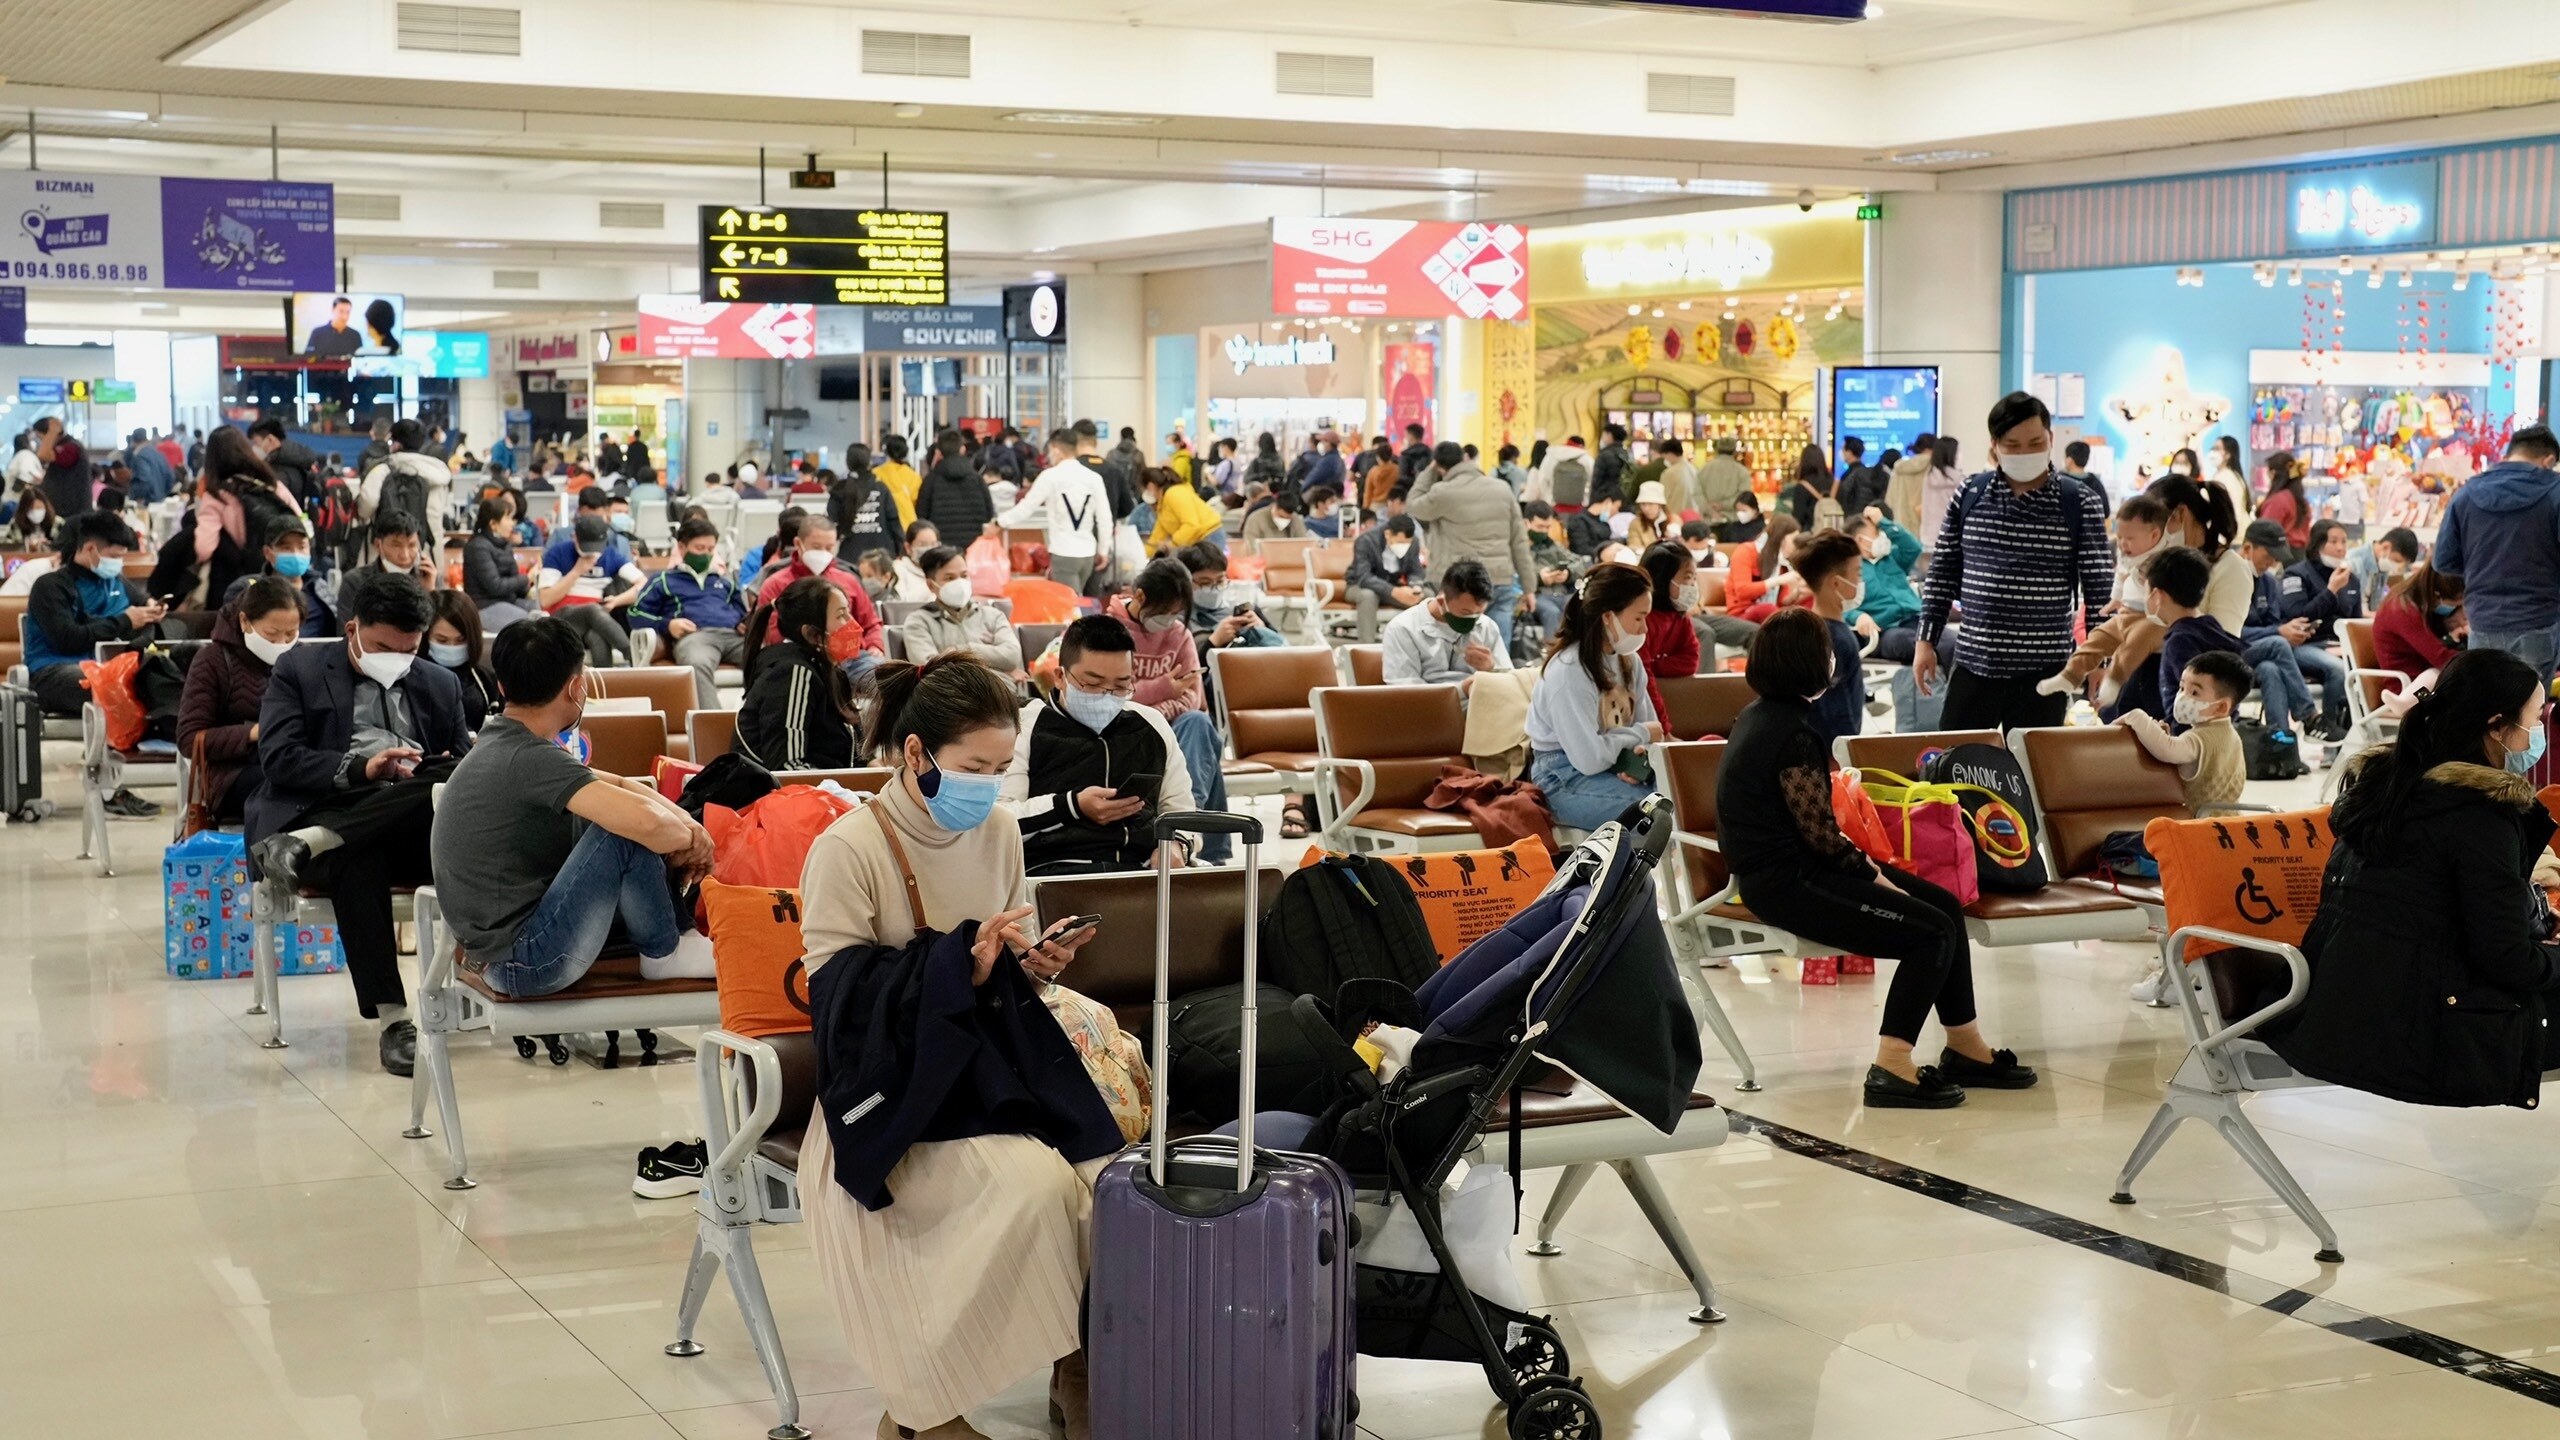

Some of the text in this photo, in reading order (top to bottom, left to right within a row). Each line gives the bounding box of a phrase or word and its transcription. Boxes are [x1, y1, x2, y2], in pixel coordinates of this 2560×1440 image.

[35, 180, 94, 193] BIZMAN
[1311, 229, 1372, 247] SHG
[14, 261, 147, 281] 094.986.98.98
[943, 311, 974, 323] LINH
[902, 327, 997, 345] SOUVENIR
[1061, 493, 1092, 531] V
[2005, 773, 2022, 797] US
[1463, 887, 1488, 896] SEAT
[1403, 1093, 1427, 1110] Combi
